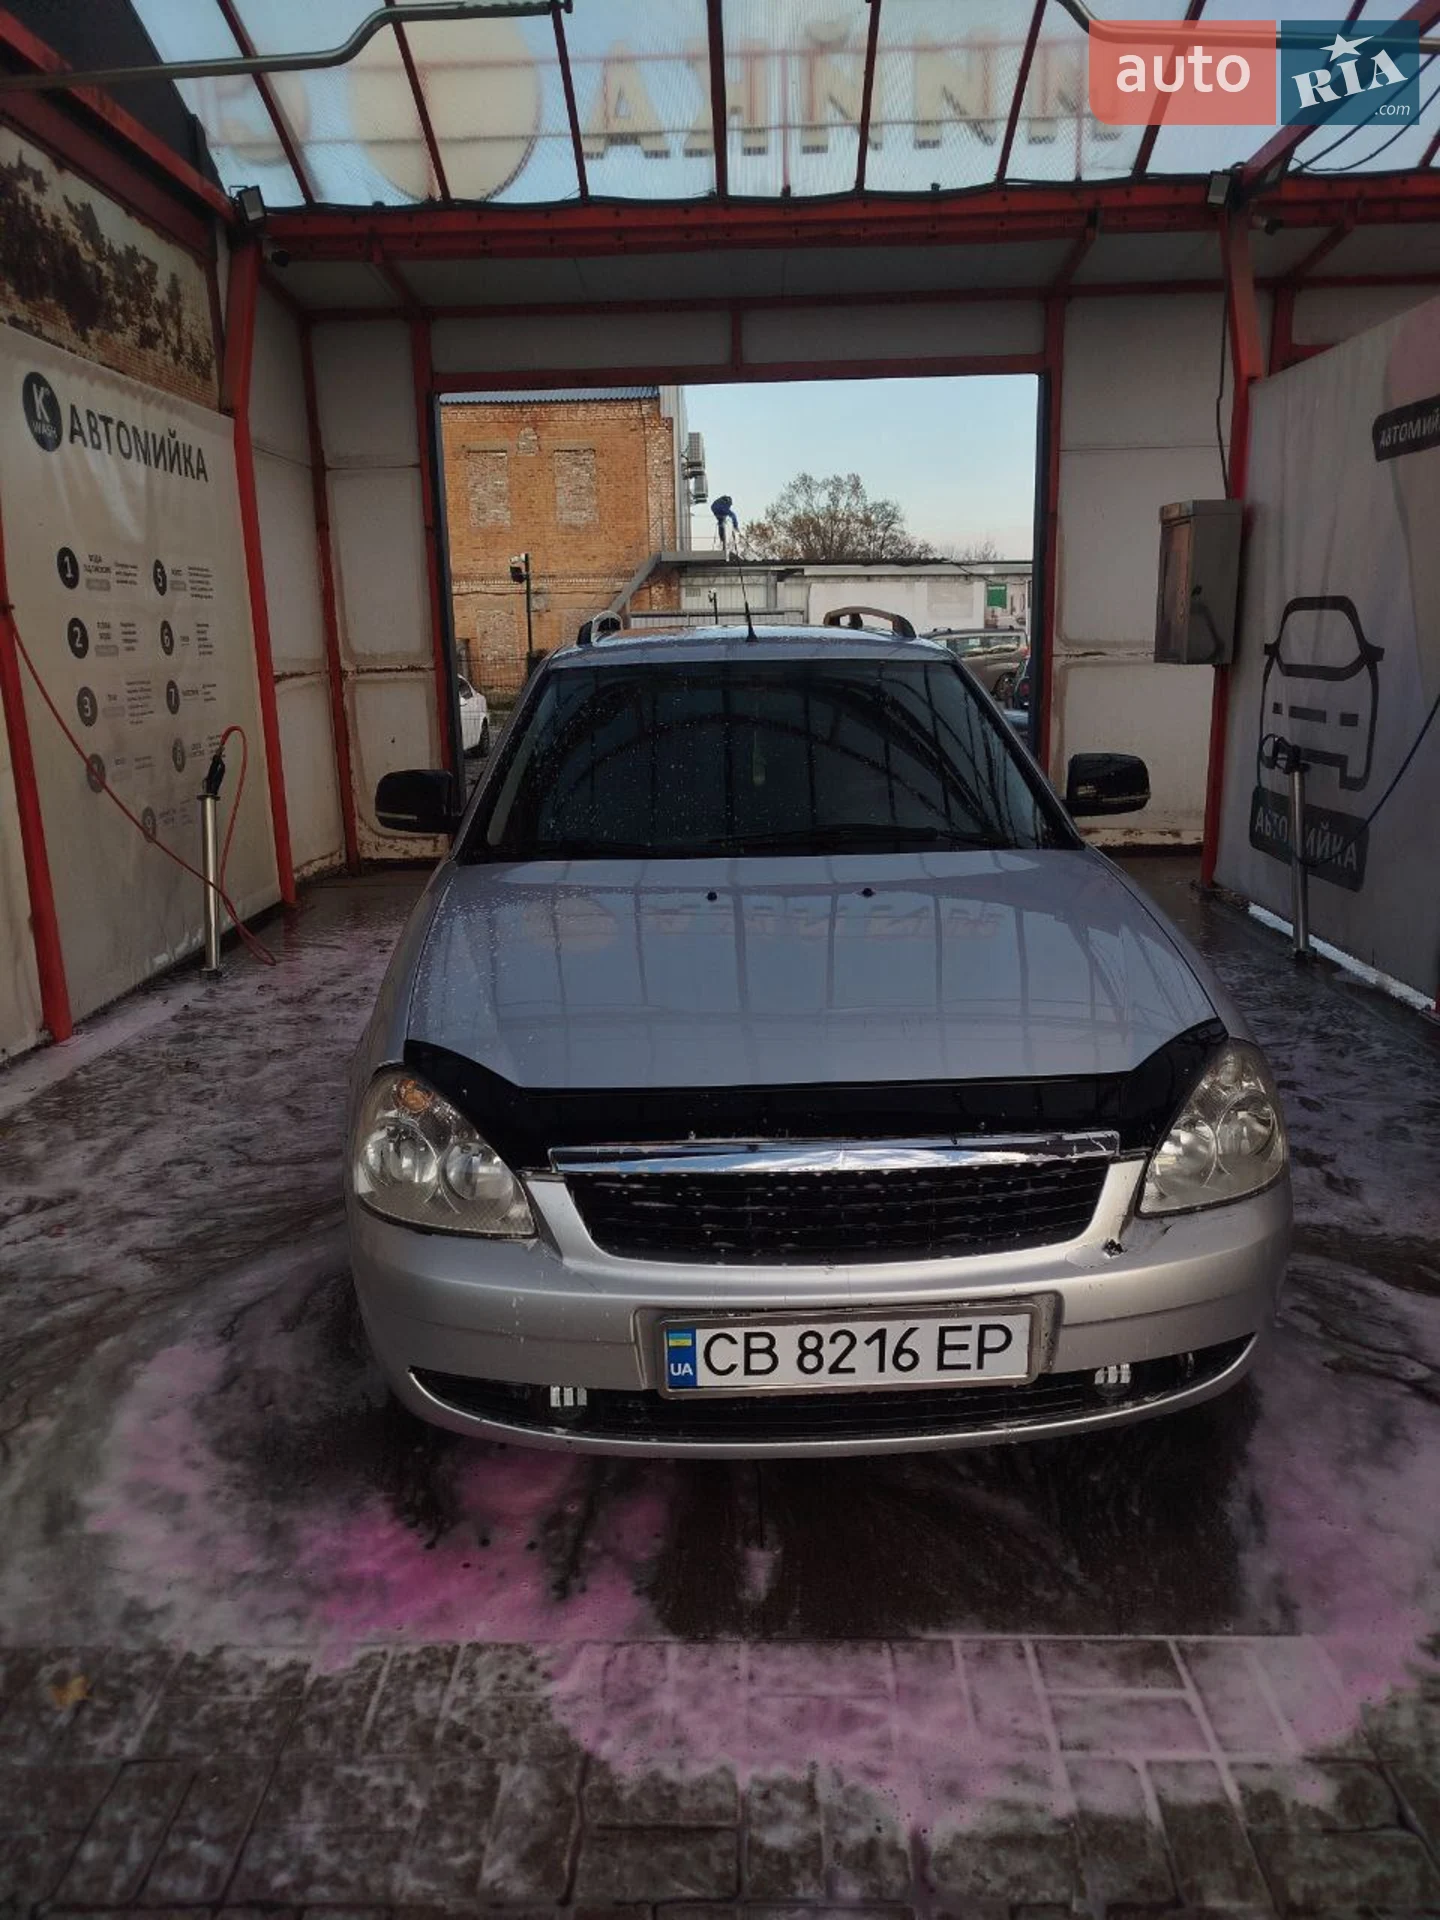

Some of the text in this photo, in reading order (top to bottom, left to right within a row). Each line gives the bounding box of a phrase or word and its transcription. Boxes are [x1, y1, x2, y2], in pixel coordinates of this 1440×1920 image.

[69, 404, 209, 483] АВТОМИЙКА
[1378, 407, 1440, 451] АВТОМИЙ
[63, 556, 73, 578] 1
[73, 626, 83, 649] 2
[82, 696, 91, 718] 3
[1255, 805, 1357, 873] АВТОИЙКА
[703, 1324, 1013, 1376] CB 8216 EP
[670, 1362, 694, 1377] UA
